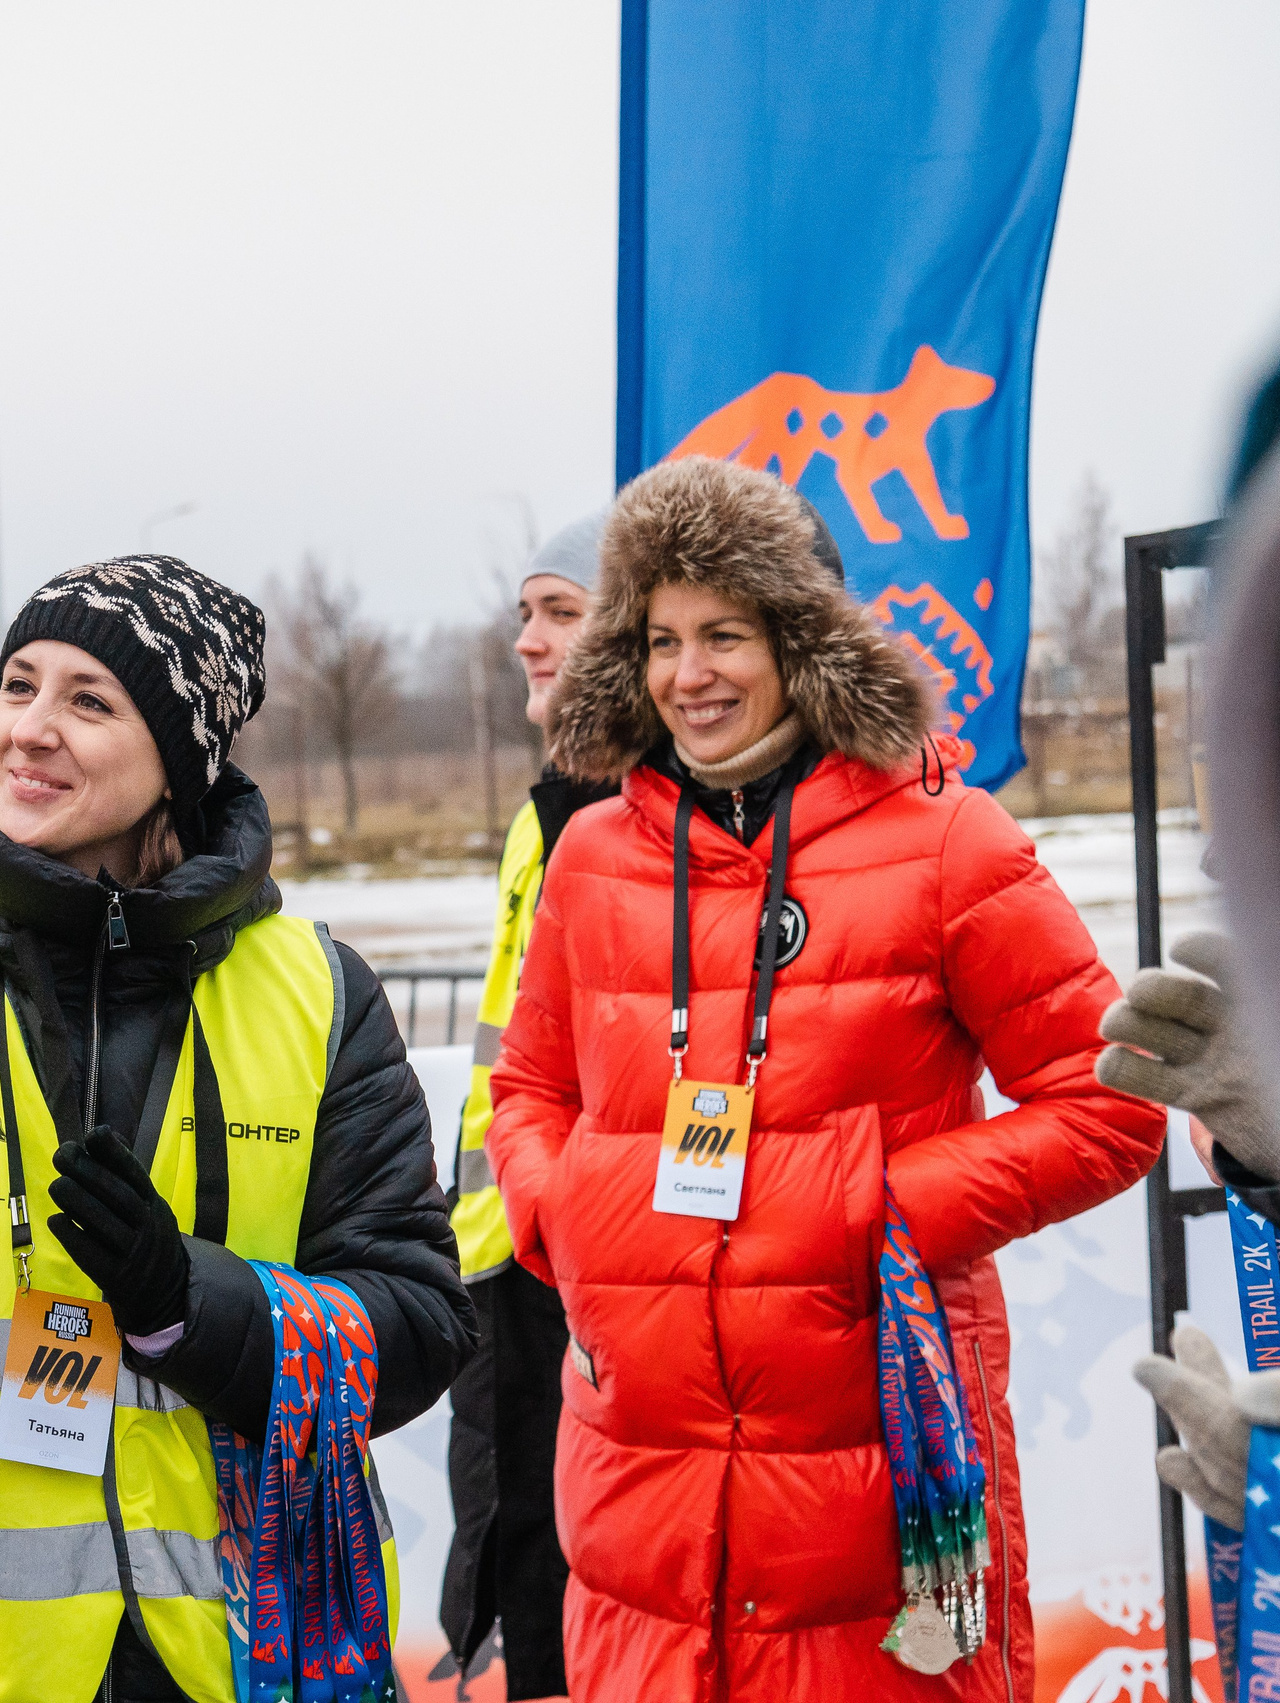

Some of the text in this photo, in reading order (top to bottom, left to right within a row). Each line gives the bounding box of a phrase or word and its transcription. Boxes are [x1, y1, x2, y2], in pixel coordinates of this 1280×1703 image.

[181, 1116, 300, 1144] ВОНТЕР
[673, 1124, 736, 1168] VOL
[674, 1183, 726, 1196] Светлана
[1242, 1242, 1271, 1272] 2K
[47, 1313, 89, 1336] HEROES
[54, 1303, 87, 1319] RUNNING
[1247, 1278, 1280, 1343] TRAIL
[18, 1345, 103, 1410] VOL
[28, 1419, 85, 1442] Татьяна
[881, 1368, 905, 1462] SNOWMAN
[263, 1464, 281, 1508] FUN
[345, 1472, 362, 1518] FUN
[256, 1513, 282, 1630] SNOWMAN
[304, 1532, 325, 1647] SNOWMAN
[351, 1520, 382, 1632] SNOWMAN
